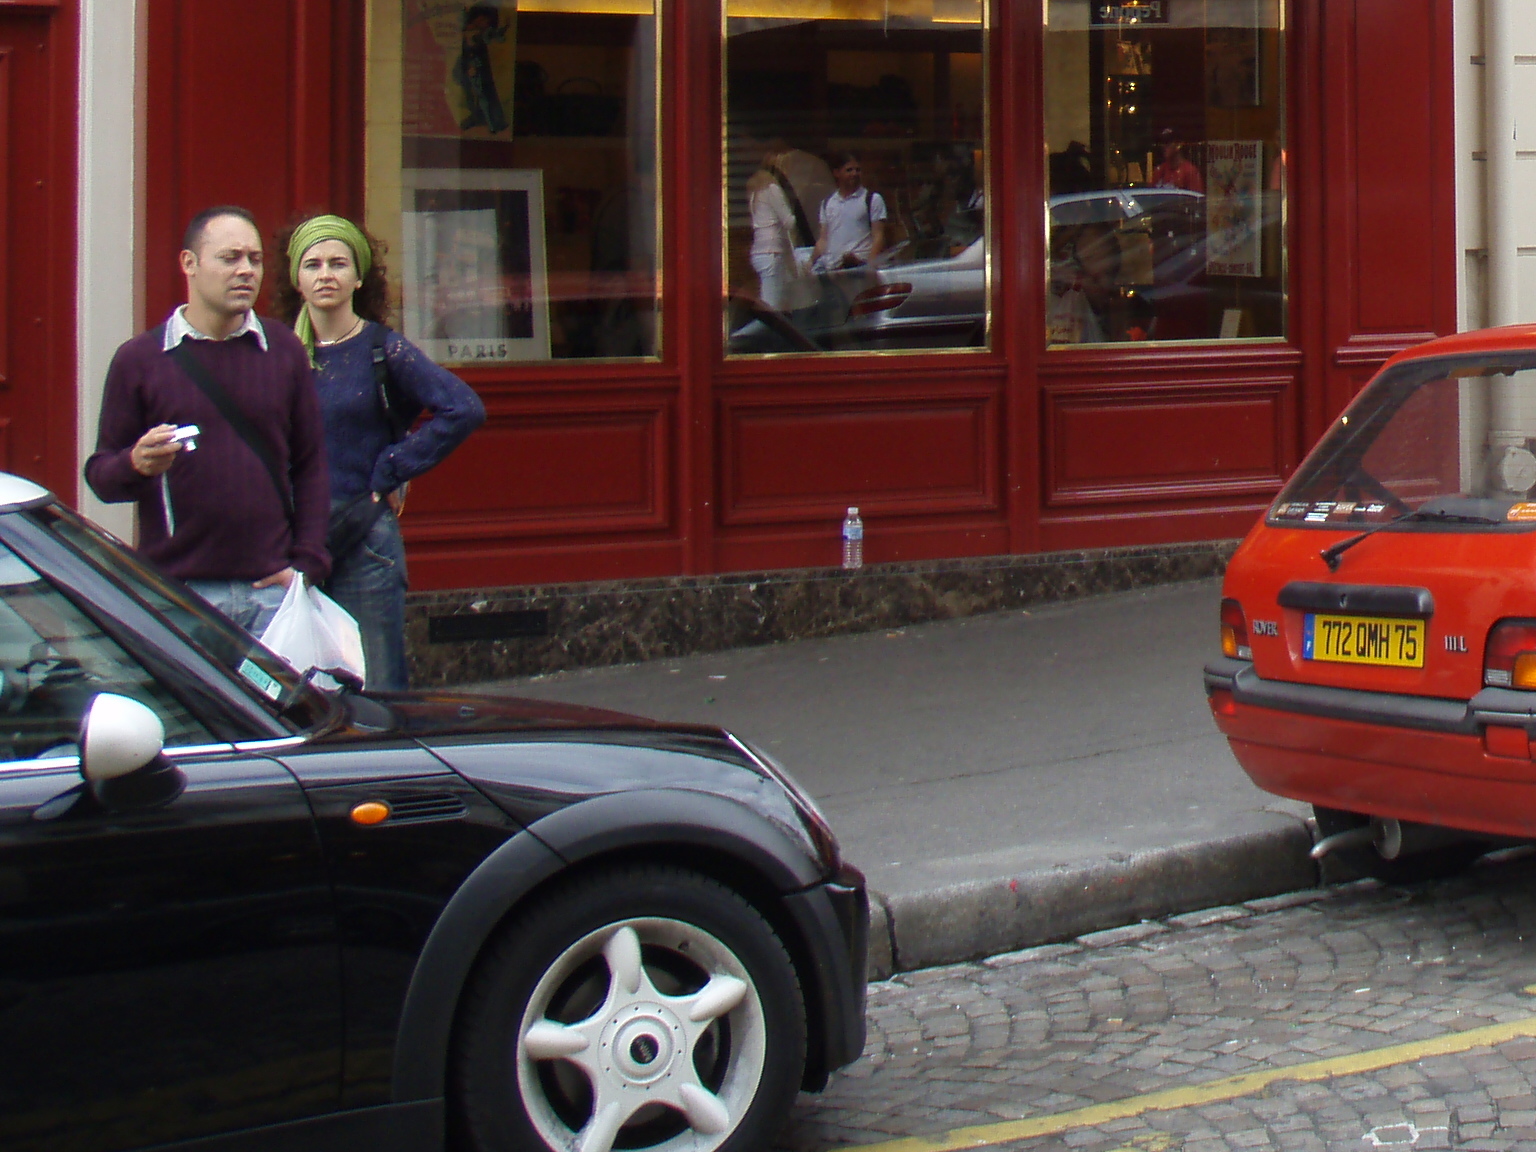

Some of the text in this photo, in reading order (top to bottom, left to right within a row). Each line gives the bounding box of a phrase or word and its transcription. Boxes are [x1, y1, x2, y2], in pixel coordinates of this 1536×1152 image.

[1322, 620, 1418, 661] 772 QMH 75
